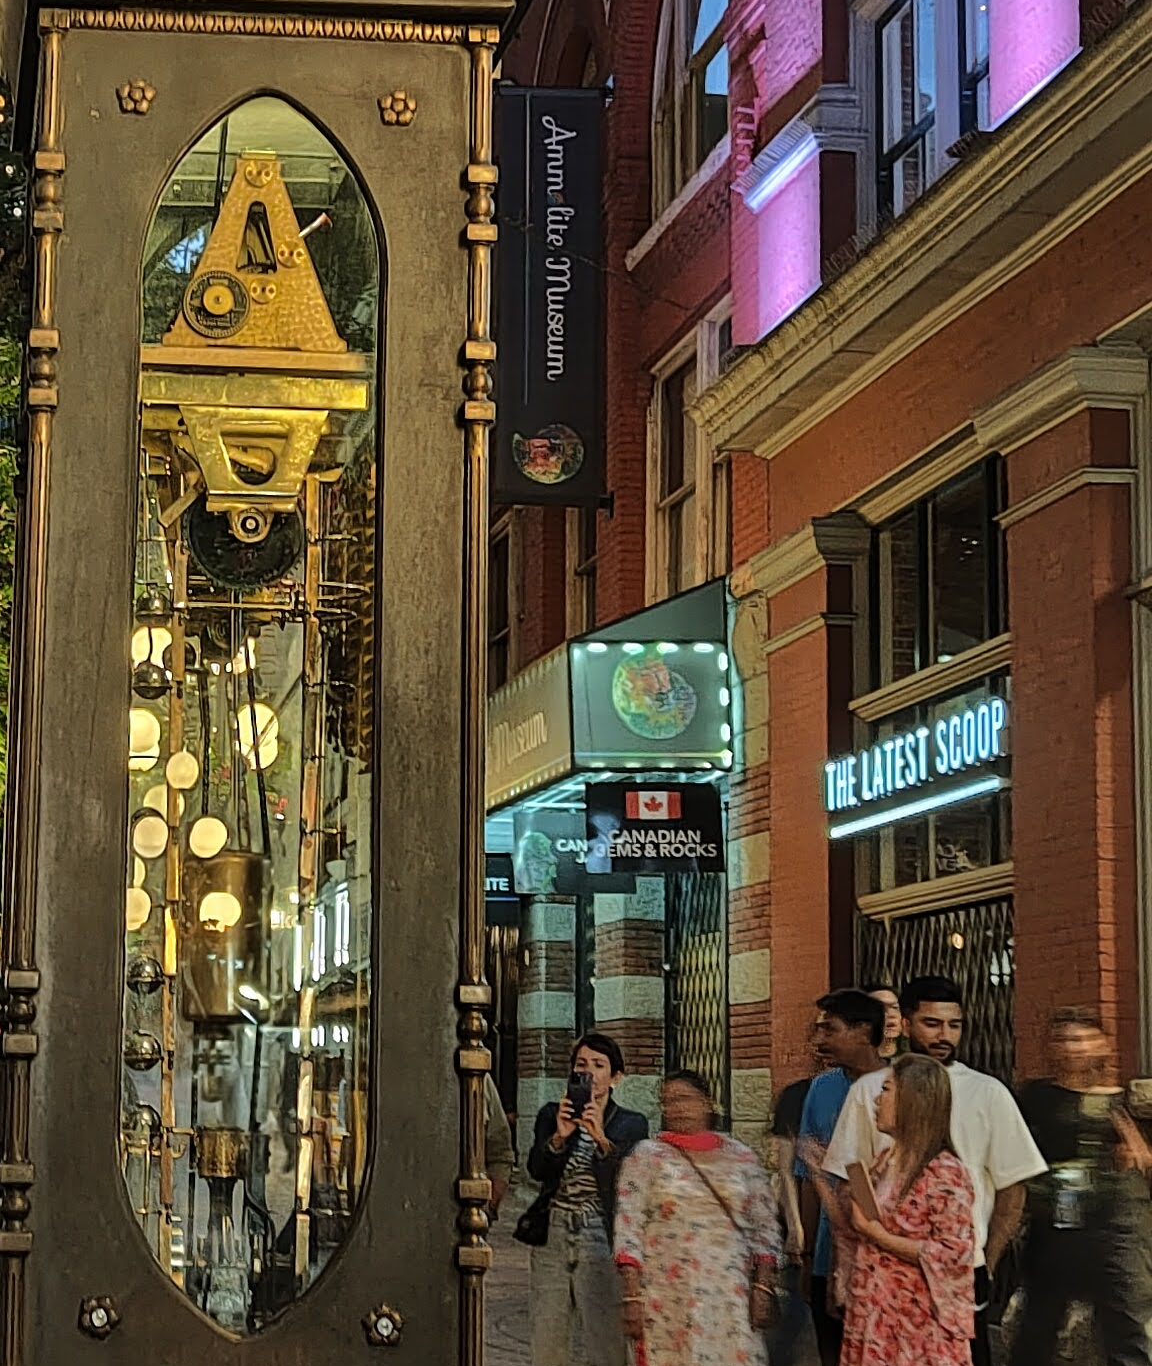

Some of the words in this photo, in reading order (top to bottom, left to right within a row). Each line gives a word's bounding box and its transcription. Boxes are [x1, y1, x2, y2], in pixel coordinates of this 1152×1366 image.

[544, 255, 572, 382] Museum
[825, 755, 859, 812] THE
[861, 726, 930, 802] LATEST
[934, 697, 1007, 775] SCOOP
[608, 829, 701, 844] CANADIAN
[644, 842, 658, 858] &
[659, 842, 718, 858] ROCKS
